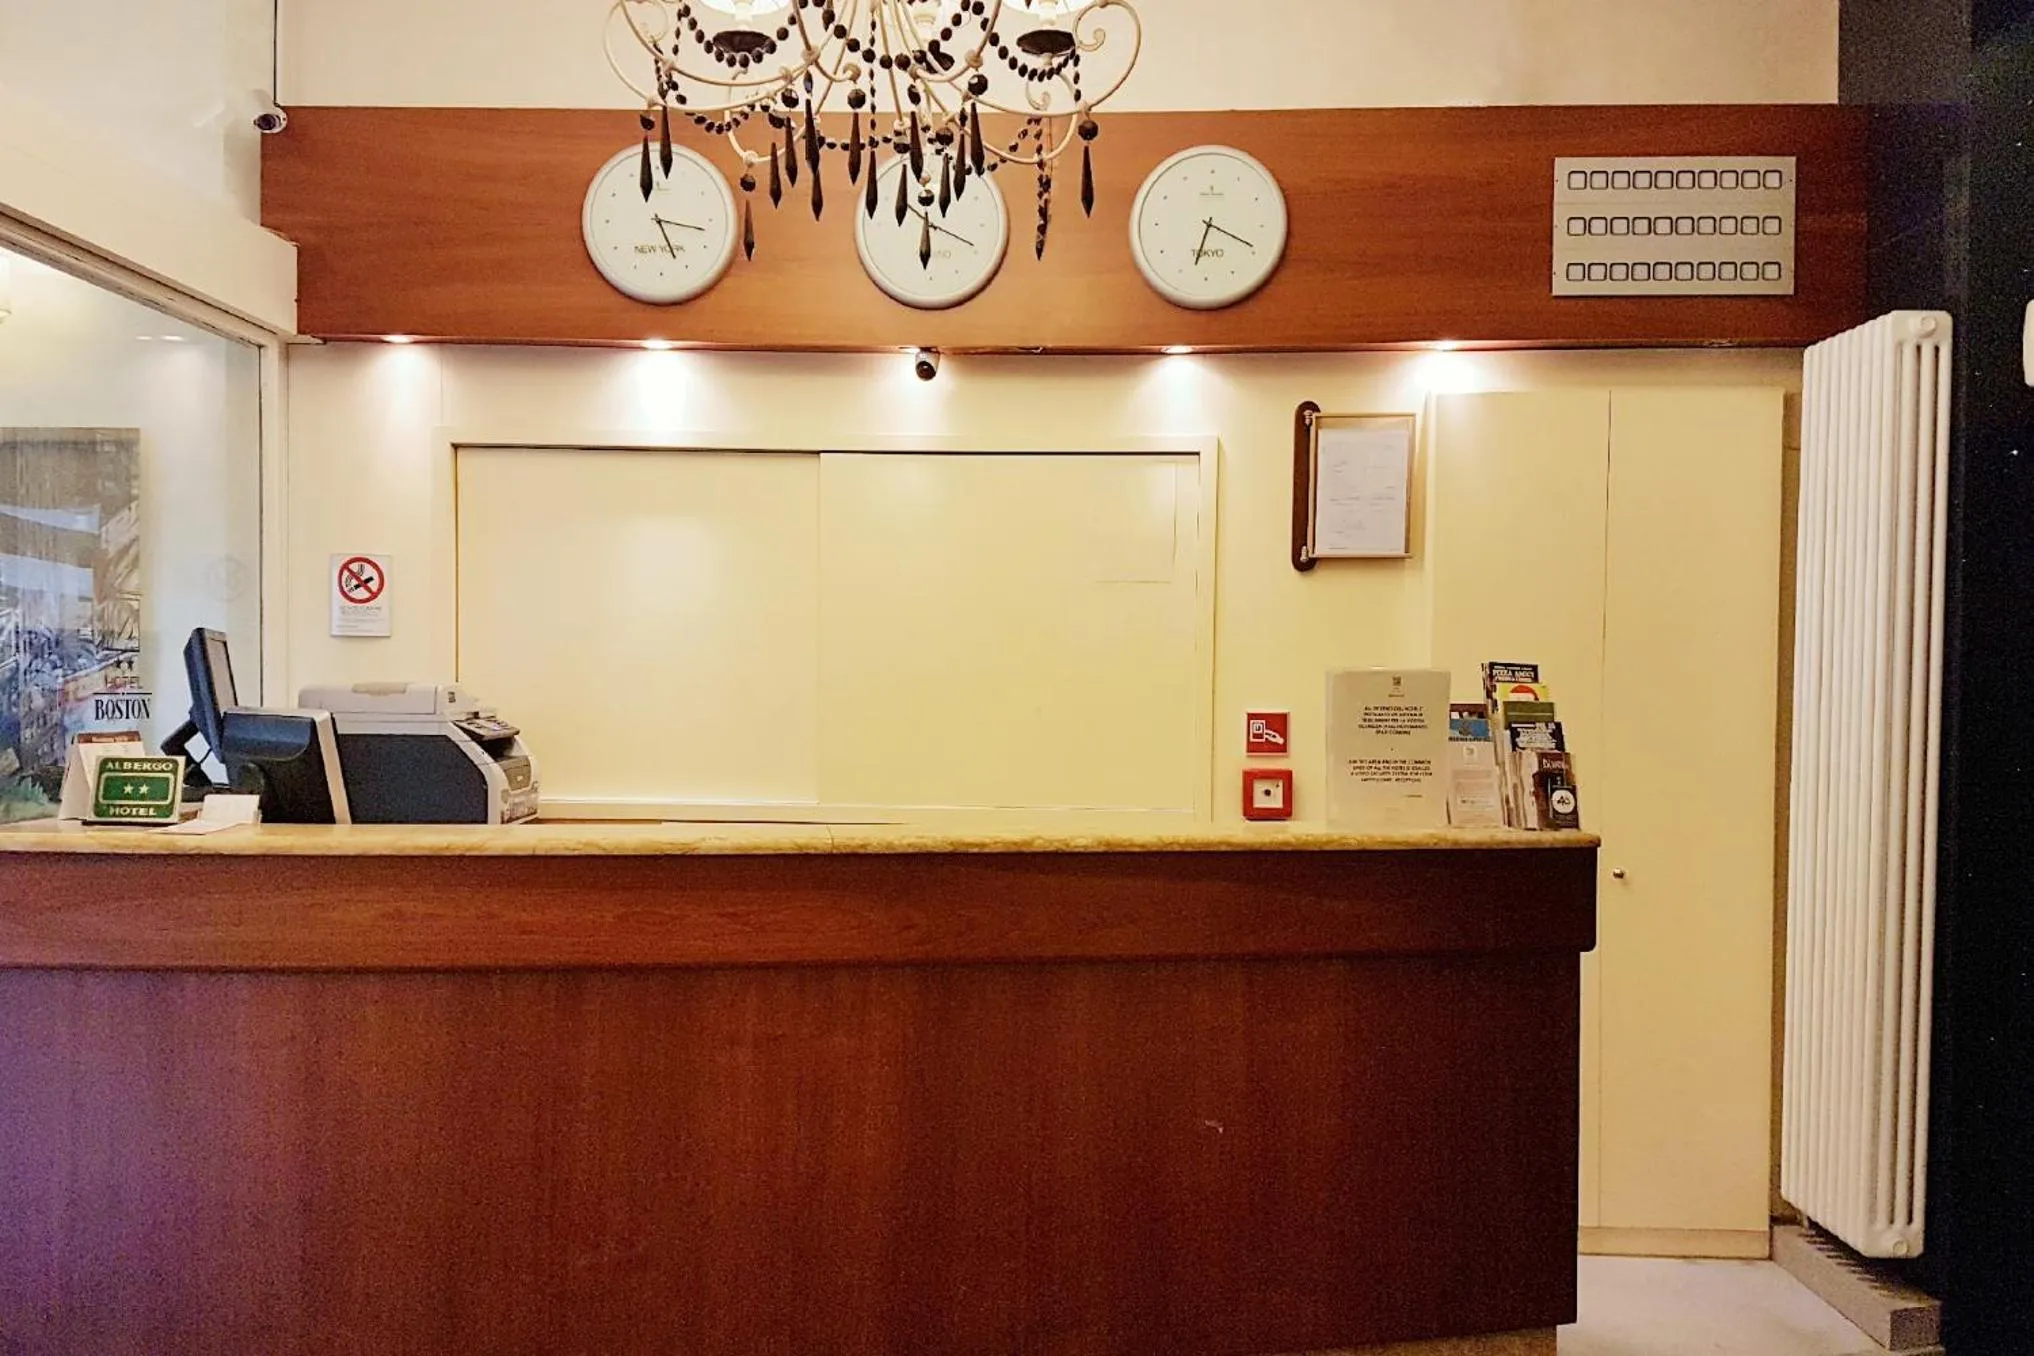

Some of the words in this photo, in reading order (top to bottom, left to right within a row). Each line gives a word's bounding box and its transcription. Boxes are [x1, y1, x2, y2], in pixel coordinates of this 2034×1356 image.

[635, 244, 656, 254] NEW
[1191, 248, 1225, 258] TOKYO
[105, 675, 144, 689] HOTEL
[94, 698, 151, 720] BOSTON
[106, 760, 173, 771] ALBERGO
[109, 805, 157, 816] HOTEL
